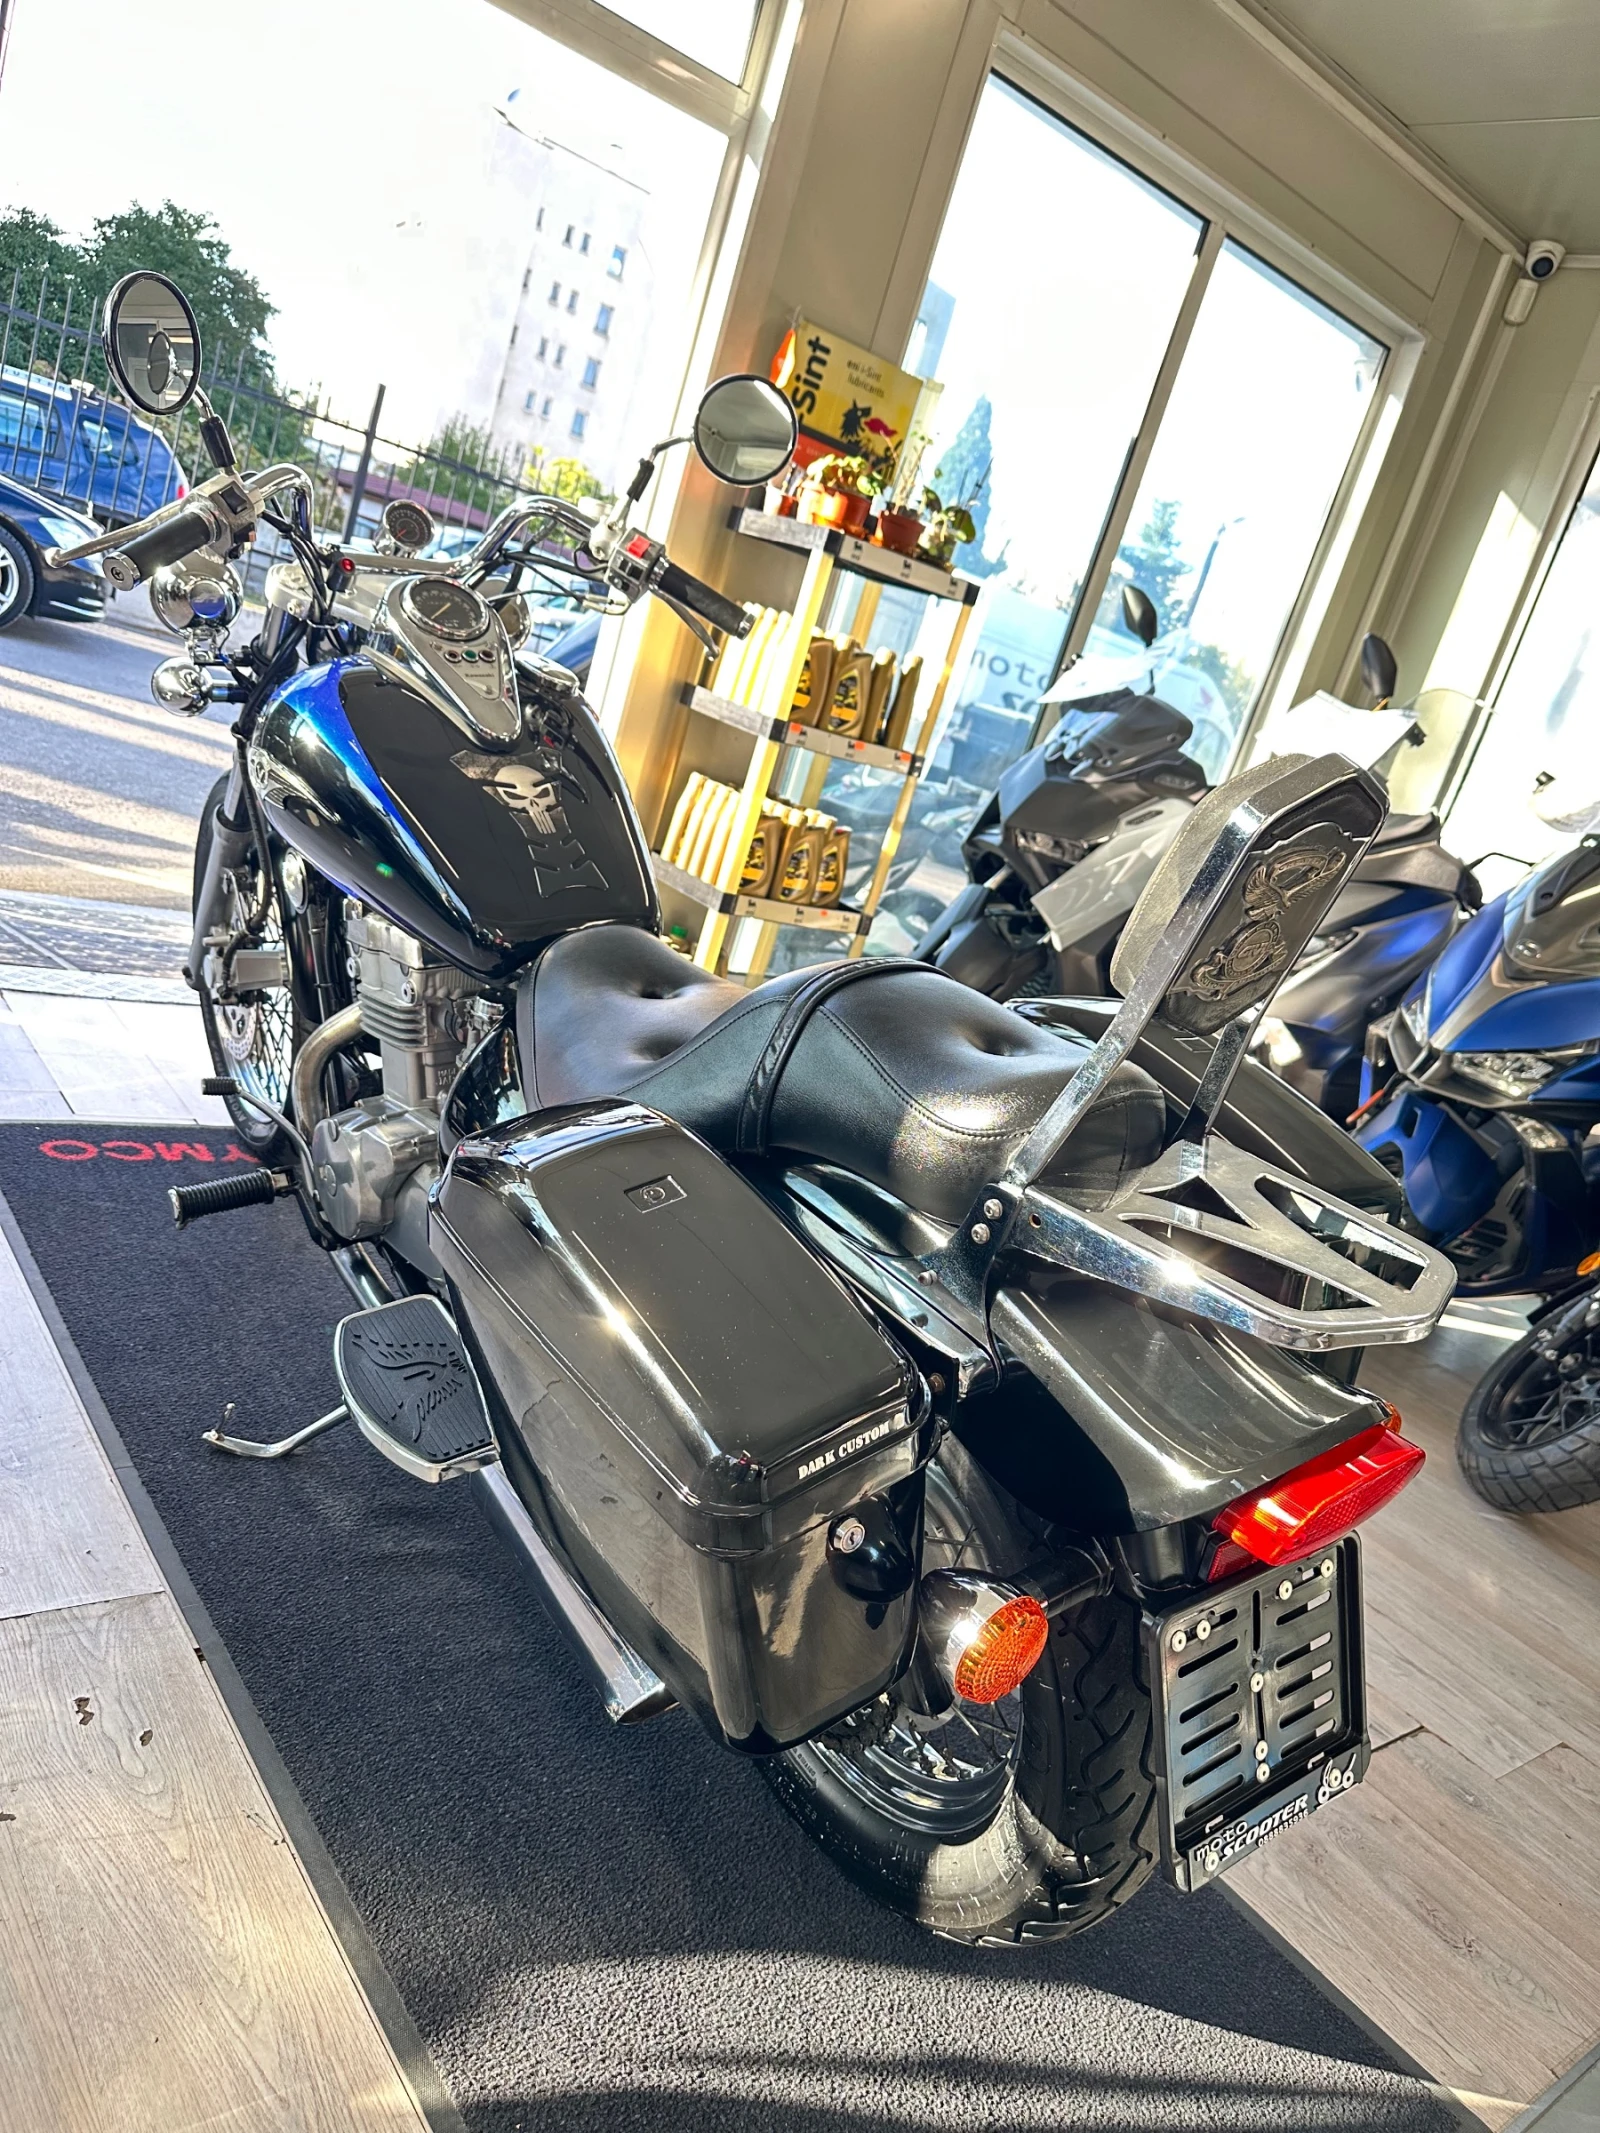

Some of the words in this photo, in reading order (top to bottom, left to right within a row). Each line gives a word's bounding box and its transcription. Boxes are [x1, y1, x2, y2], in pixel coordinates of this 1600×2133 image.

[791, 335, 832, 425] -Sint
[38, 1139, 262, 1164] YMCO
[797, 1449, 836, 1480] DARK
[838, 1420, 890, 1458] CUSTOM
[1196, 1821, 1248, 1861] moto
[1221, 1793, 1309, 1862] SCOOTER
